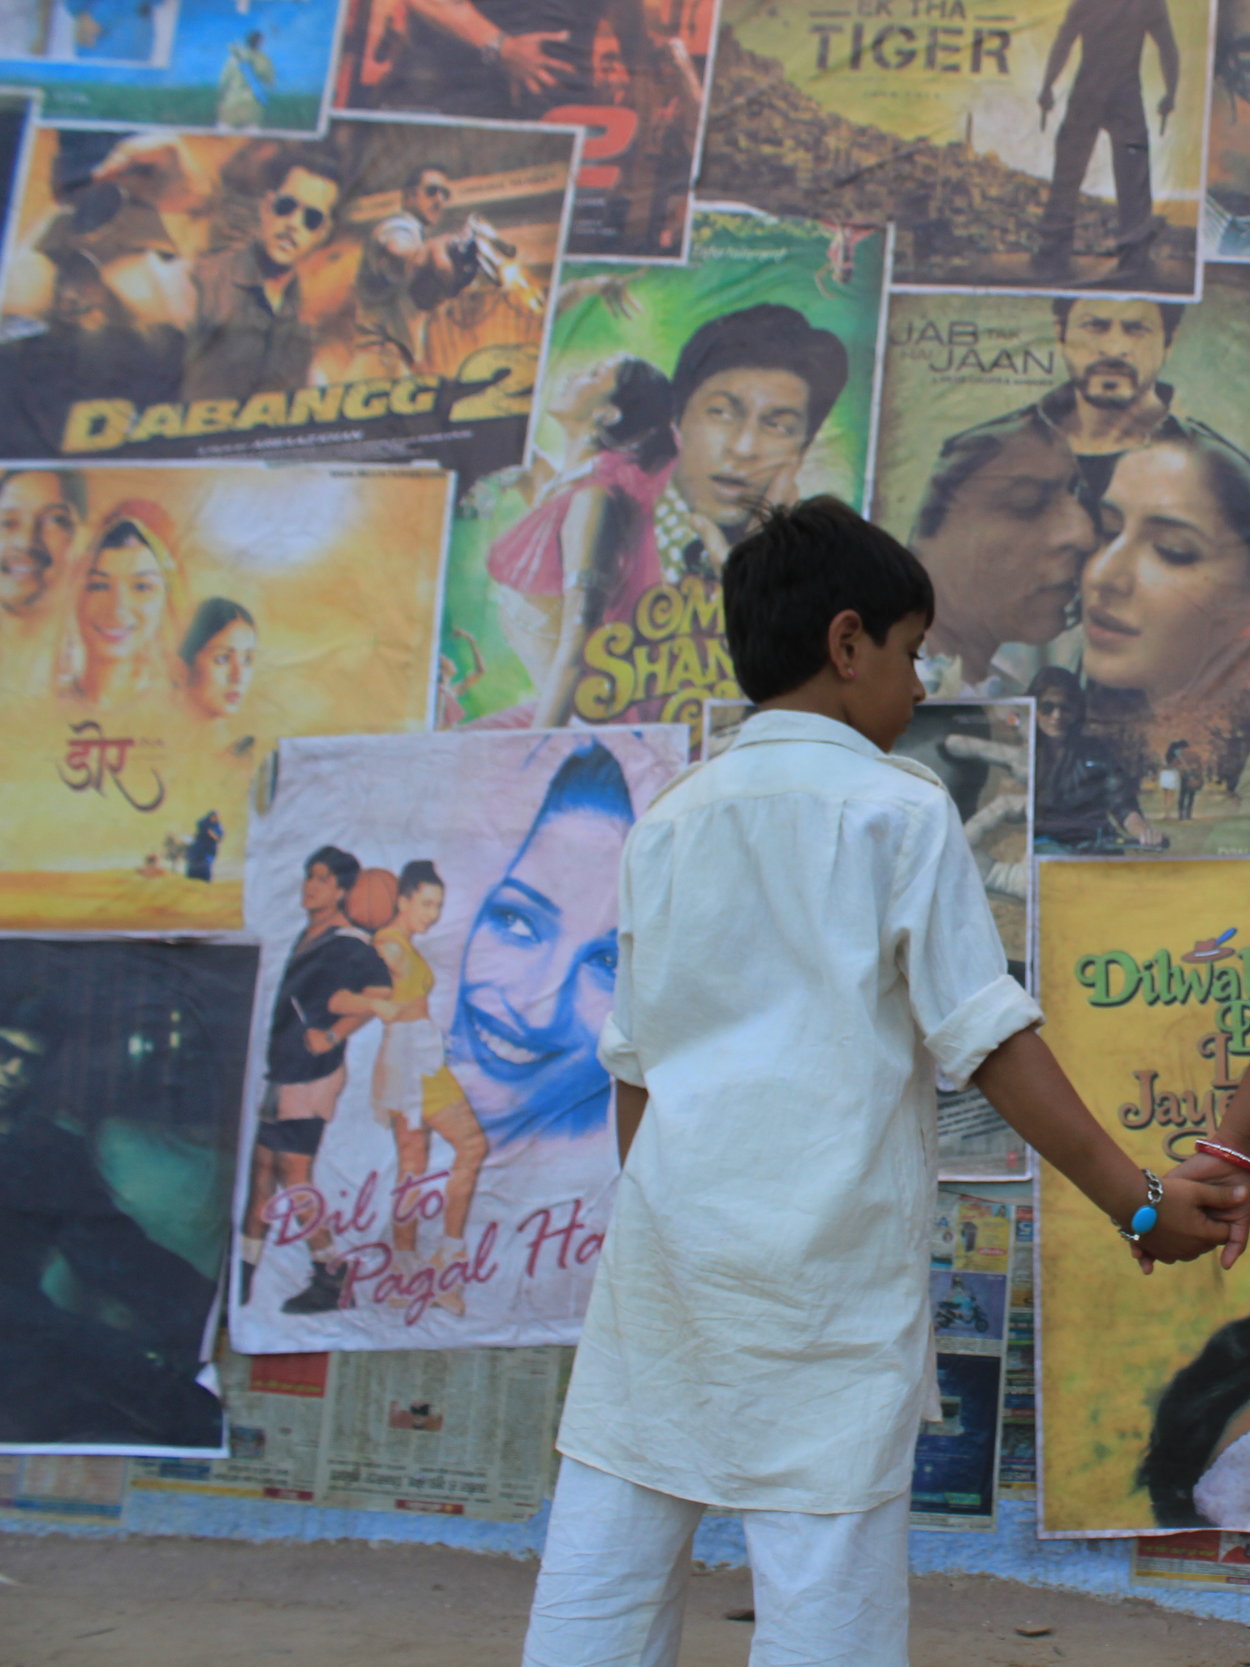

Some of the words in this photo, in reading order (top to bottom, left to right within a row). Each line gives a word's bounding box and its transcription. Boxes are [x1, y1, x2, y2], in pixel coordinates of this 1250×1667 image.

[808, 22, 1011, 74] TIGER
[889, 320, 979, 346] JAB
[929, 348, 1056, 375] JAAN
[60, 375, 441, 453] DABANGG
[449, 344, 537, 422] 2
[635, 574, 726, 641] OM
[574, 621, 737, 720] SHAN
[58, 720, 166, 813] डोर
[264, 1170, 378, 1246] Dil
[392, 1171, 450, 1223] to
[326, 1222, 498, 1327] Pagal
[517, 1199, 606, 1278] Ha
